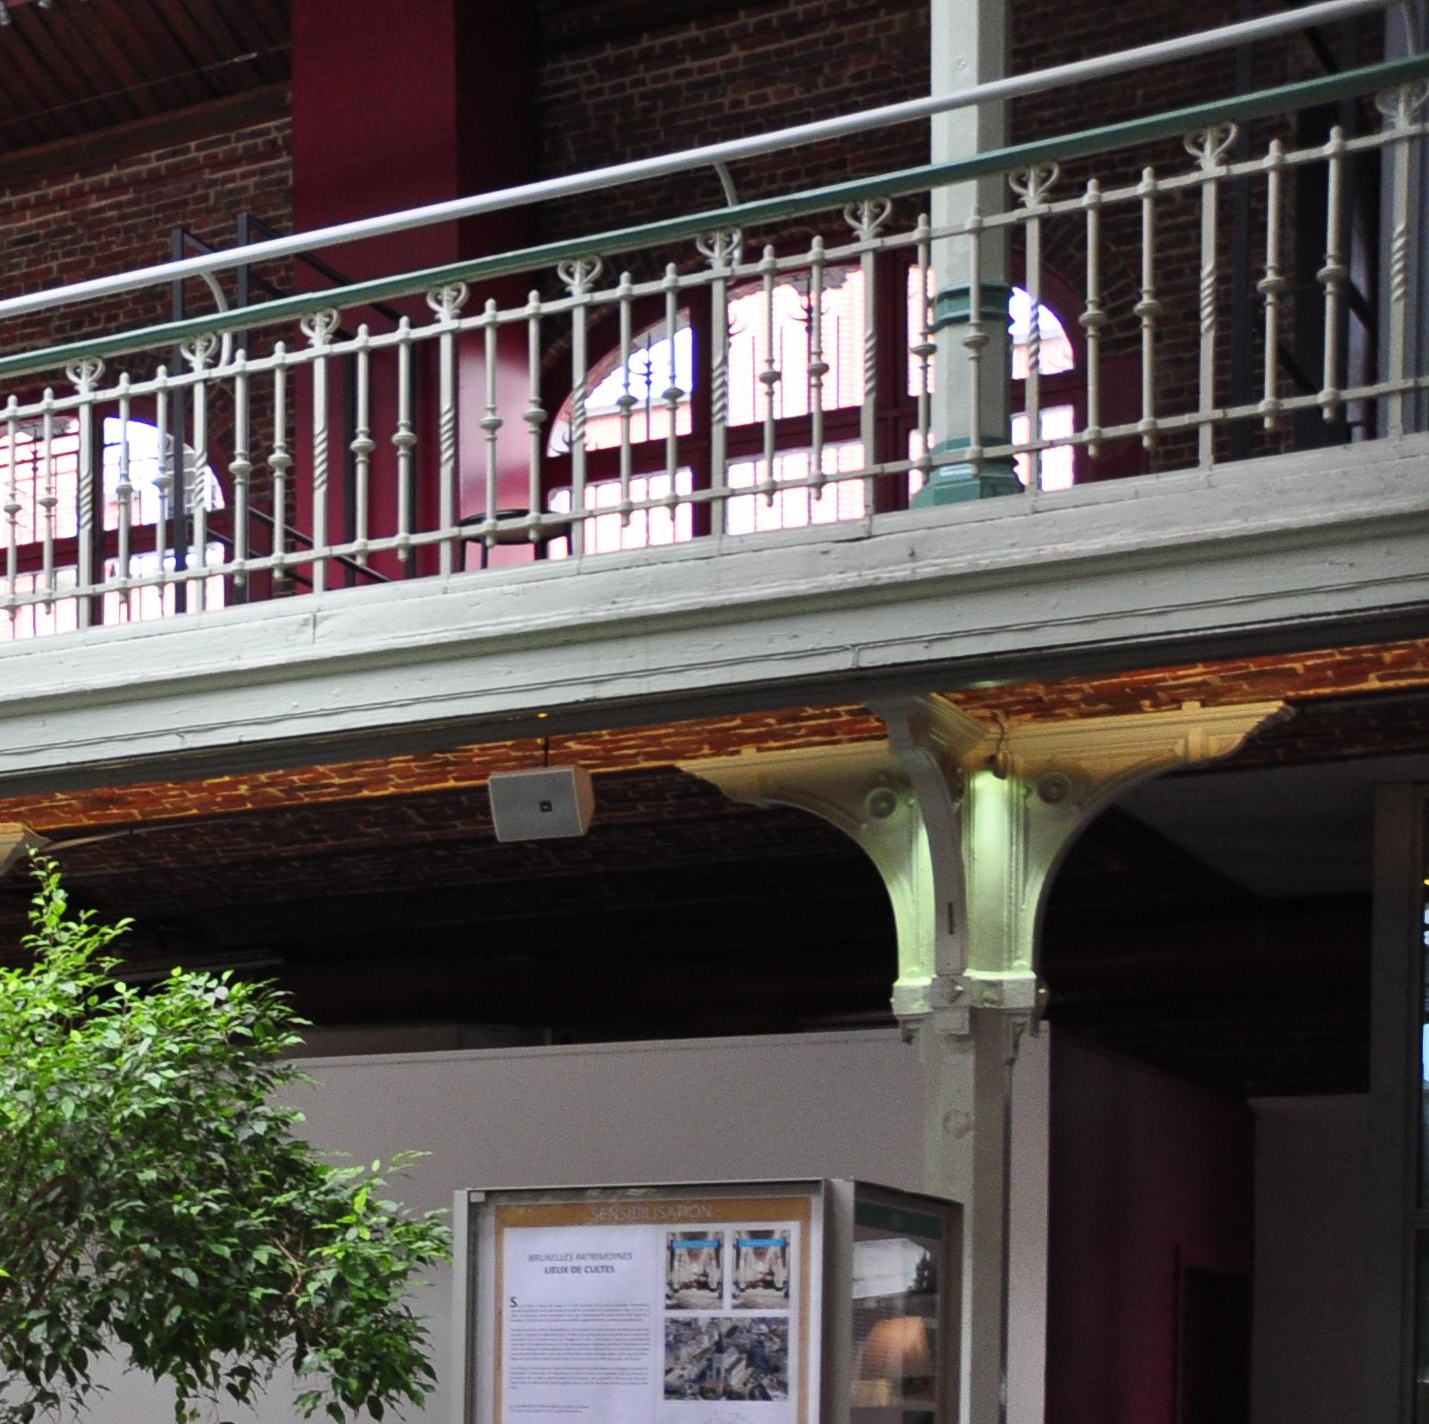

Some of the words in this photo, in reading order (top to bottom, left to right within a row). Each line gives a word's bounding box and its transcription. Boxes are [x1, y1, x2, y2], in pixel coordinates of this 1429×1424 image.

[590, 1204, 712, 1220] SENSIBILISATION
[528, 1253, 573, 1262] BRUXELLES
[544, 1265, 568, 1274] LIEUX
[571, 1265, 582, 1274] DE
[584, 1265, 615, 1274] CULTES
